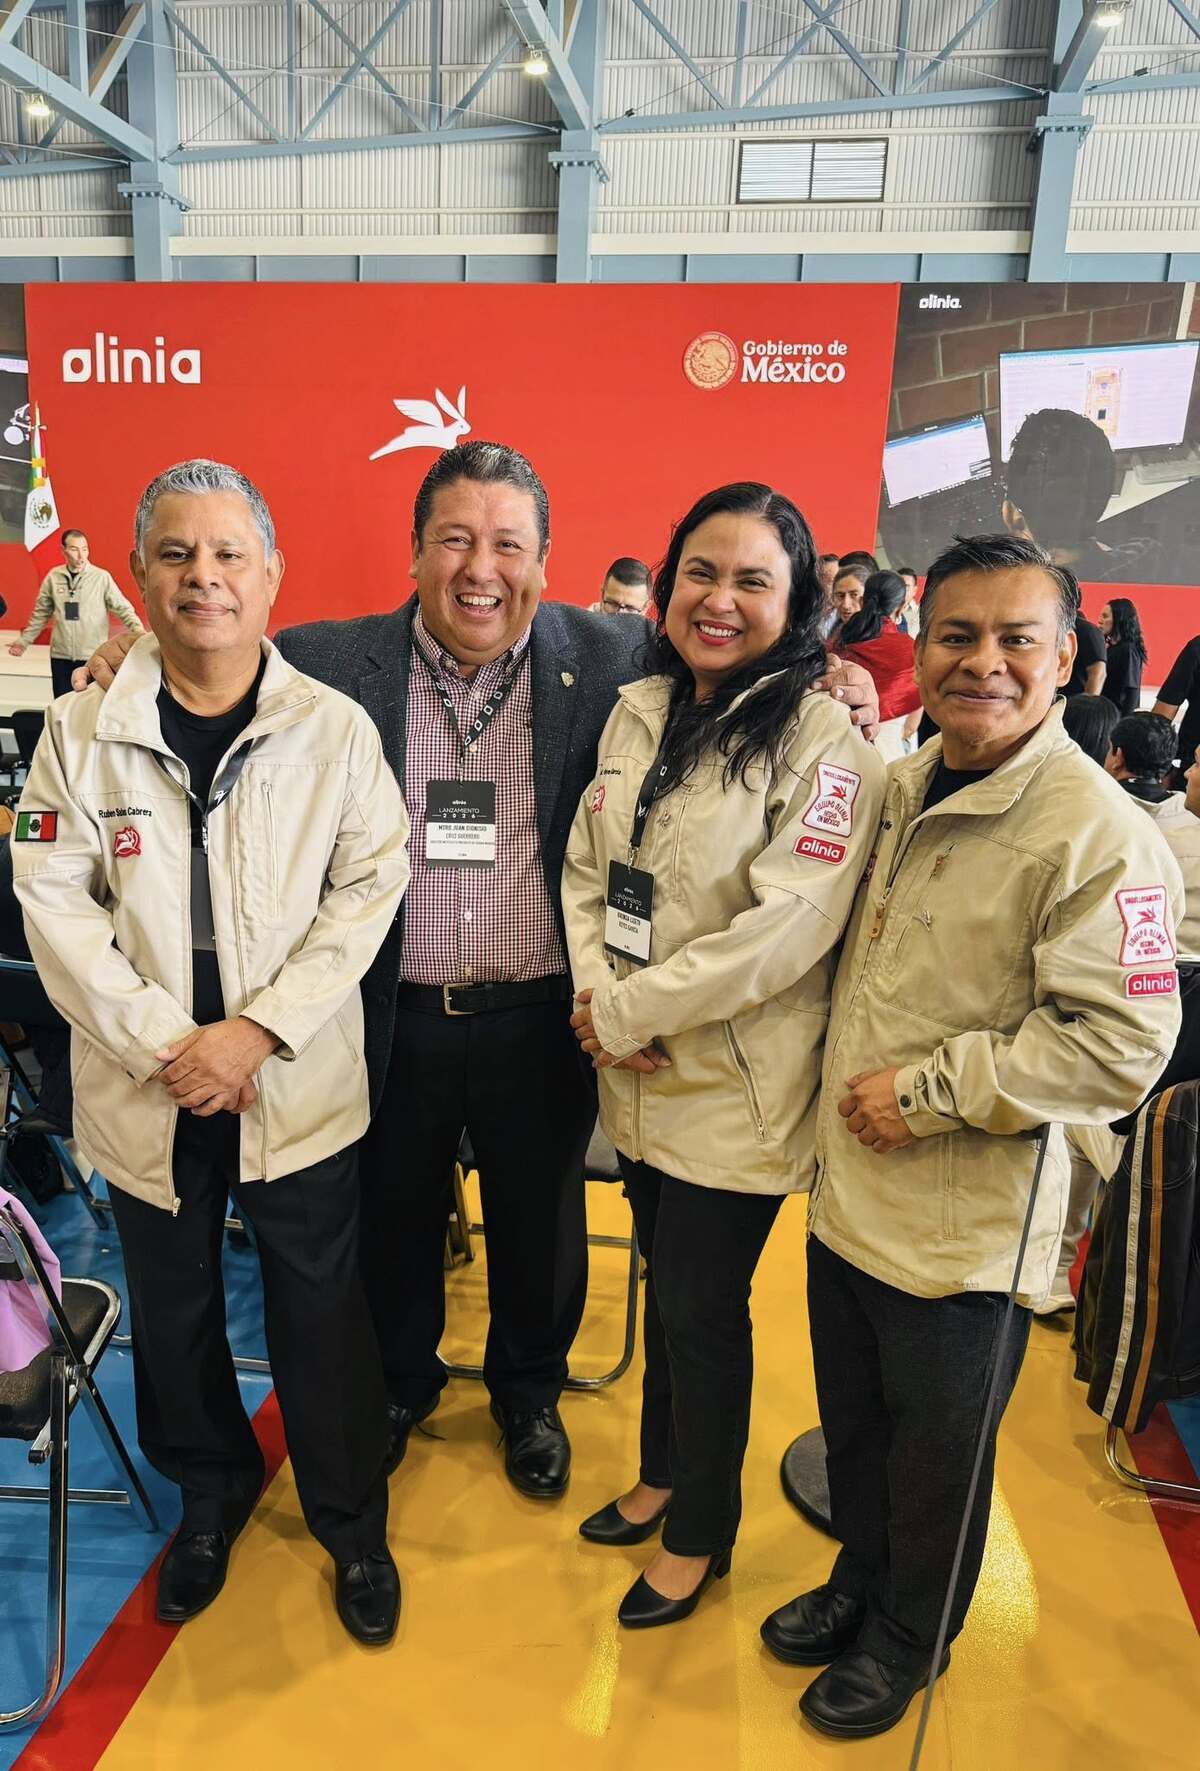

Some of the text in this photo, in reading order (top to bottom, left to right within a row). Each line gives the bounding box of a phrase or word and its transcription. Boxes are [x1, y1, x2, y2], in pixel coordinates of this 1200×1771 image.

[62, 332, 201, 384] olinia
[742, 340, 848, 356] Gobierno de
[740, 356, 846, 383] México
[127, 806, 152, 817] Cabrera
